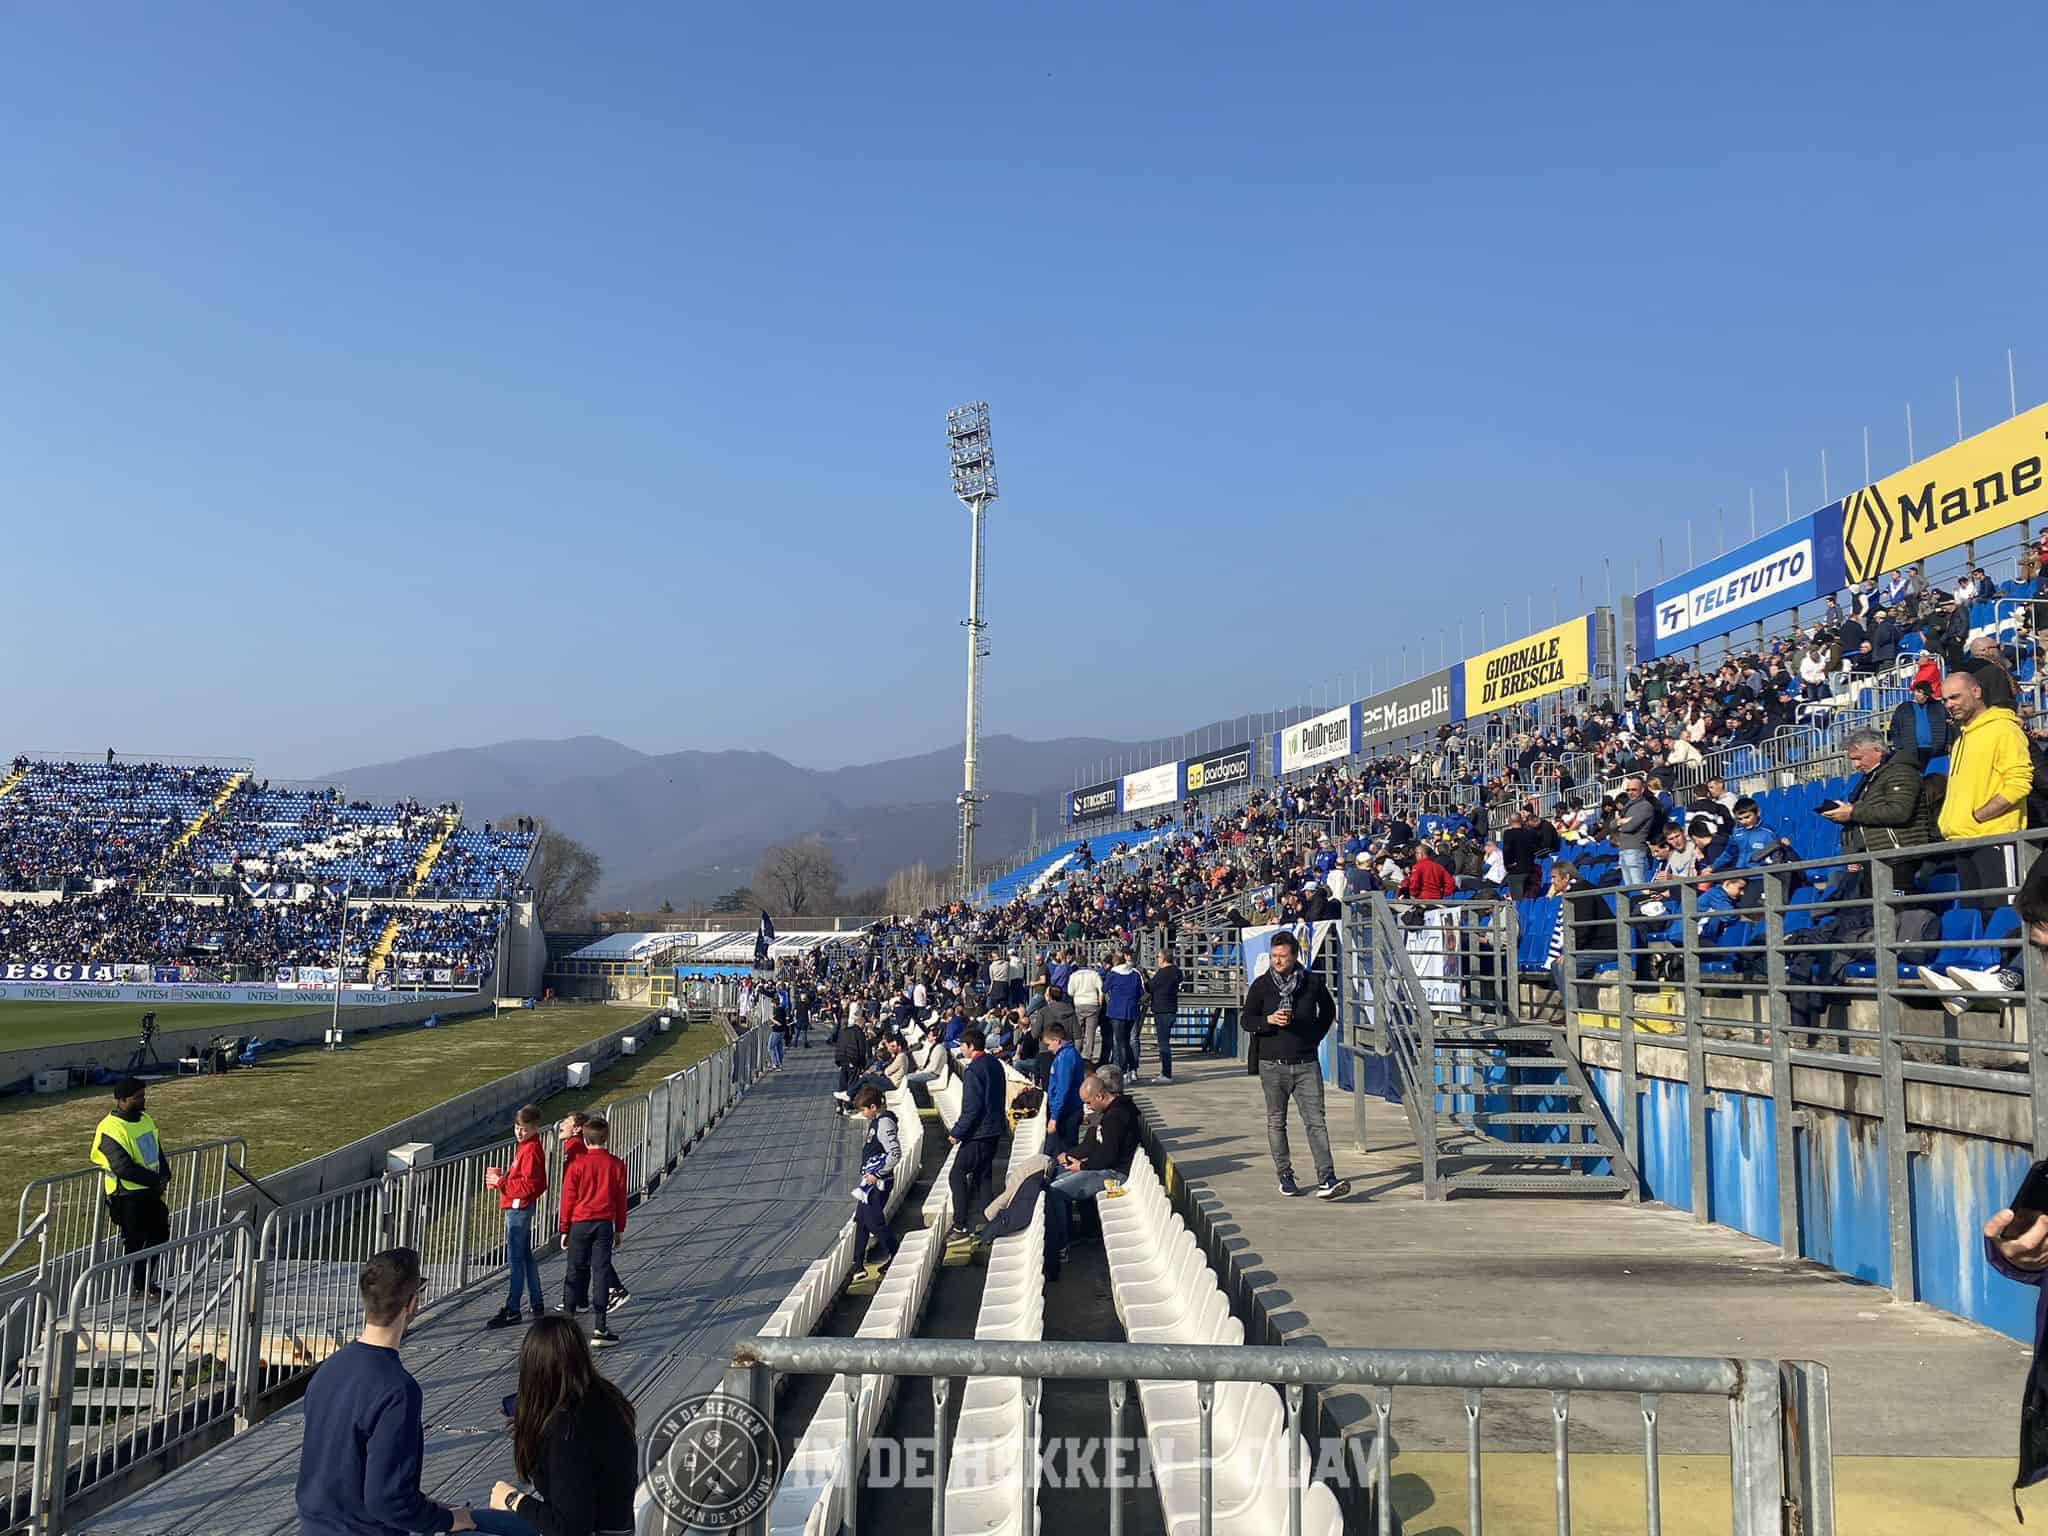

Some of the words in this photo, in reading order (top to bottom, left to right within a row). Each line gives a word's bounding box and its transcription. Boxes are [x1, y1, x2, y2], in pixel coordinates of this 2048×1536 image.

[1897, 431, 2048, 543] Mane
[1695, 552, 1805, 617] TELETUTTO
[1486, 637, 1561, 680] GIORNALE
[1482, 681, 1498, 704] DI
[1500, 659, 1565, 698] BRESCIA
[1382, 686, 1450, 731] Manelli
[1302, 718, 1348, 753] PuliDream
[1205, 760, 1246, 782] pardgroup
